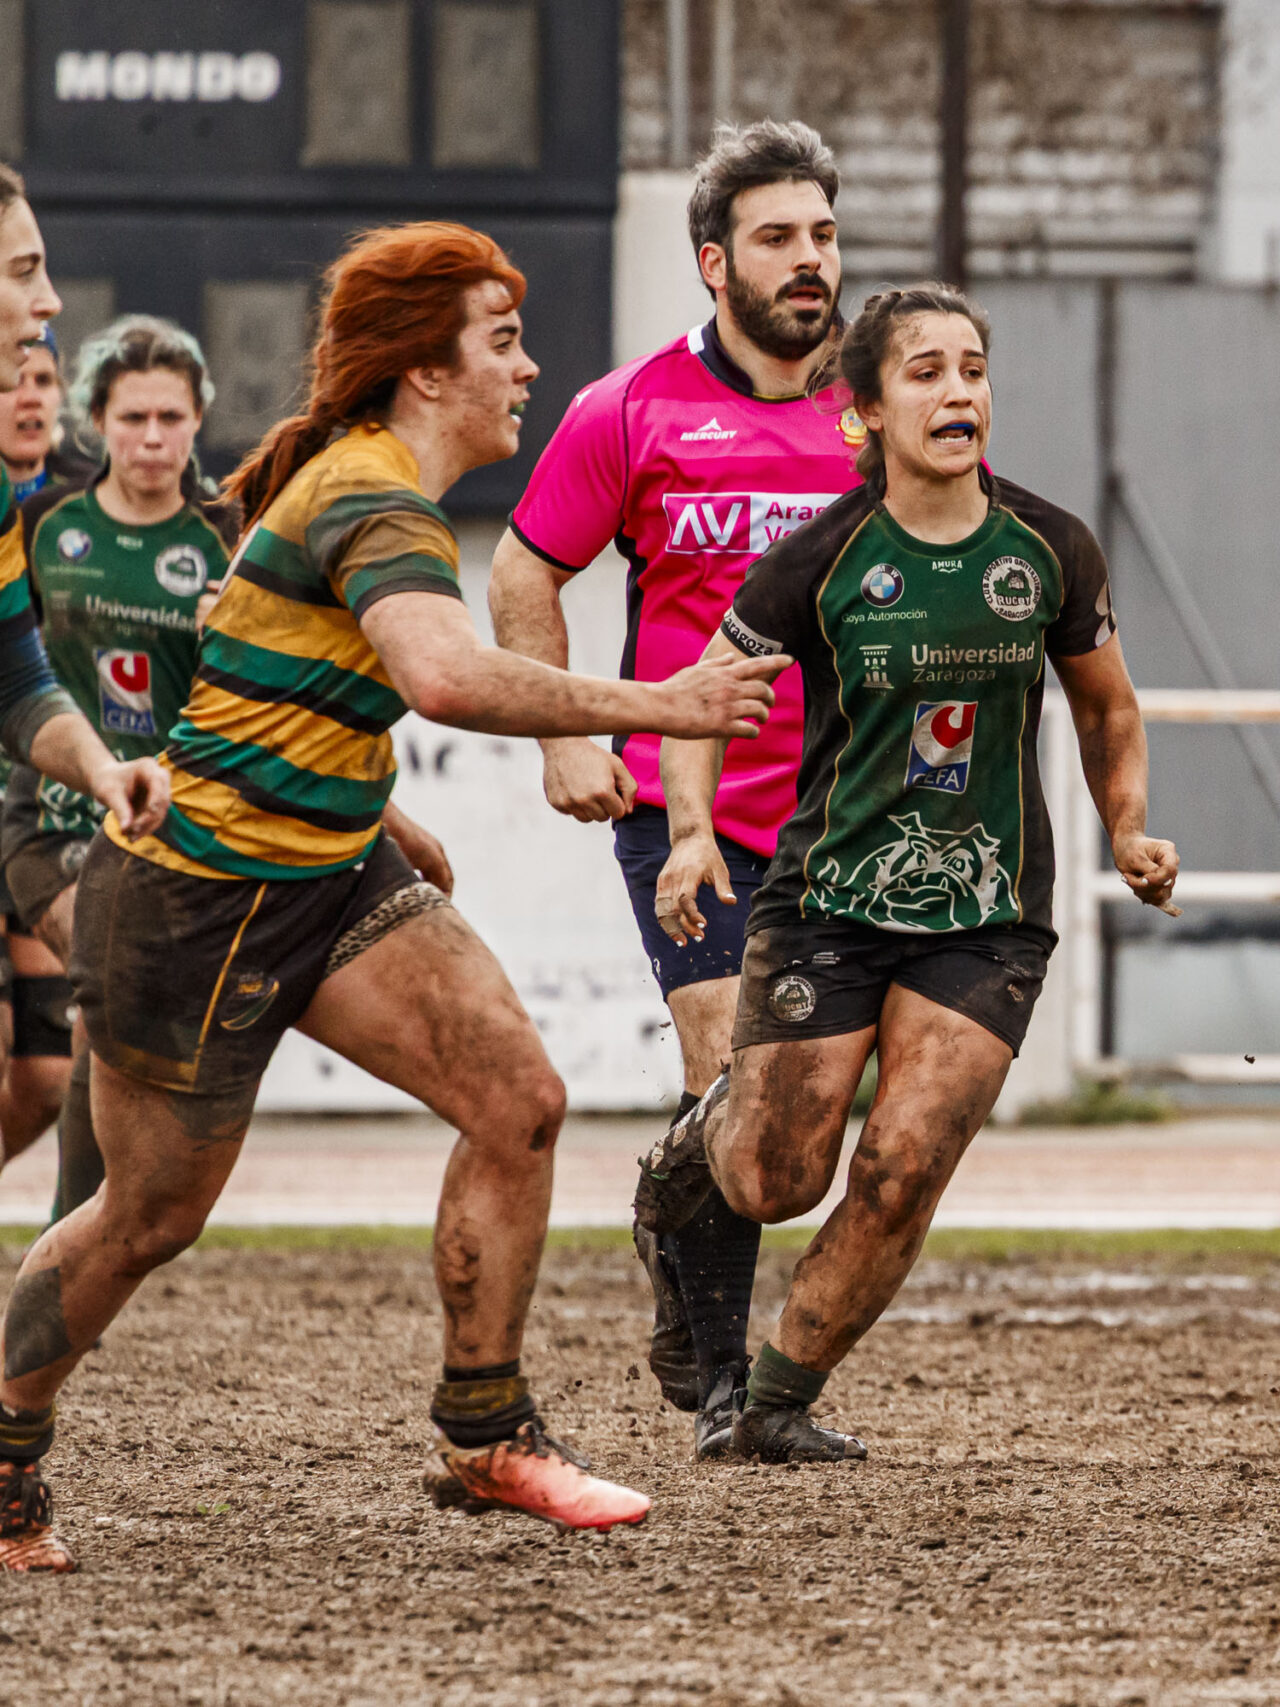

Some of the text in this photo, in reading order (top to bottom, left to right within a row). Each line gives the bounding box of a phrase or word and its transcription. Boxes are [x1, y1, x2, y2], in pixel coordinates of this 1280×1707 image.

[55, 48, 282, 102] MONDO
[680, 430, 738, 442] MERCURY
[931, 559, 964, 571] AMURA
[867, 608, 928, 622] Automoción
[911, 640, 1036, 666] Universidad
[912, 668, 997, 685] Zaragoza
[911, 768, 961, 790] CEFA
